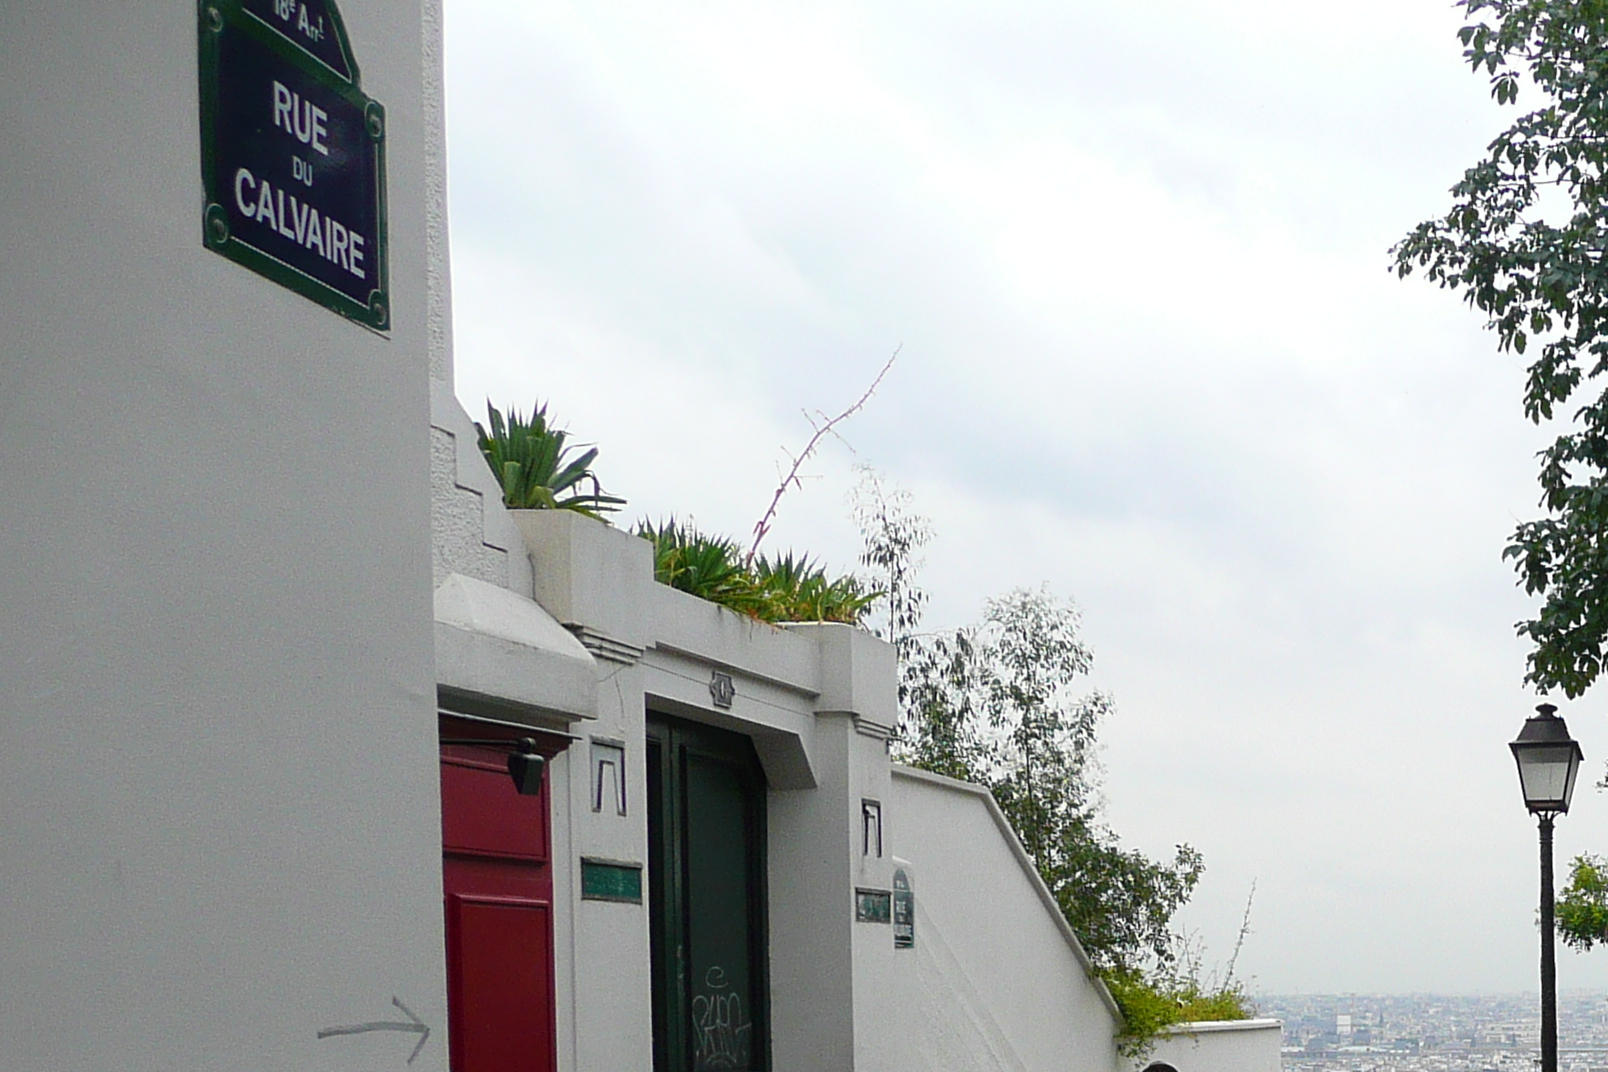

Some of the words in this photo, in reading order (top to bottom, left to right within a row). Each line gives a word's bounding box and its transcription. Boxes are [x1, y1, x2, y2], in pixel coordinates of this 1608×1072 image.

[273, 80, 328, 156] RUE
[292, 155, 313, 187] DU
[235, 167, 365, 280] CALVAIRE
